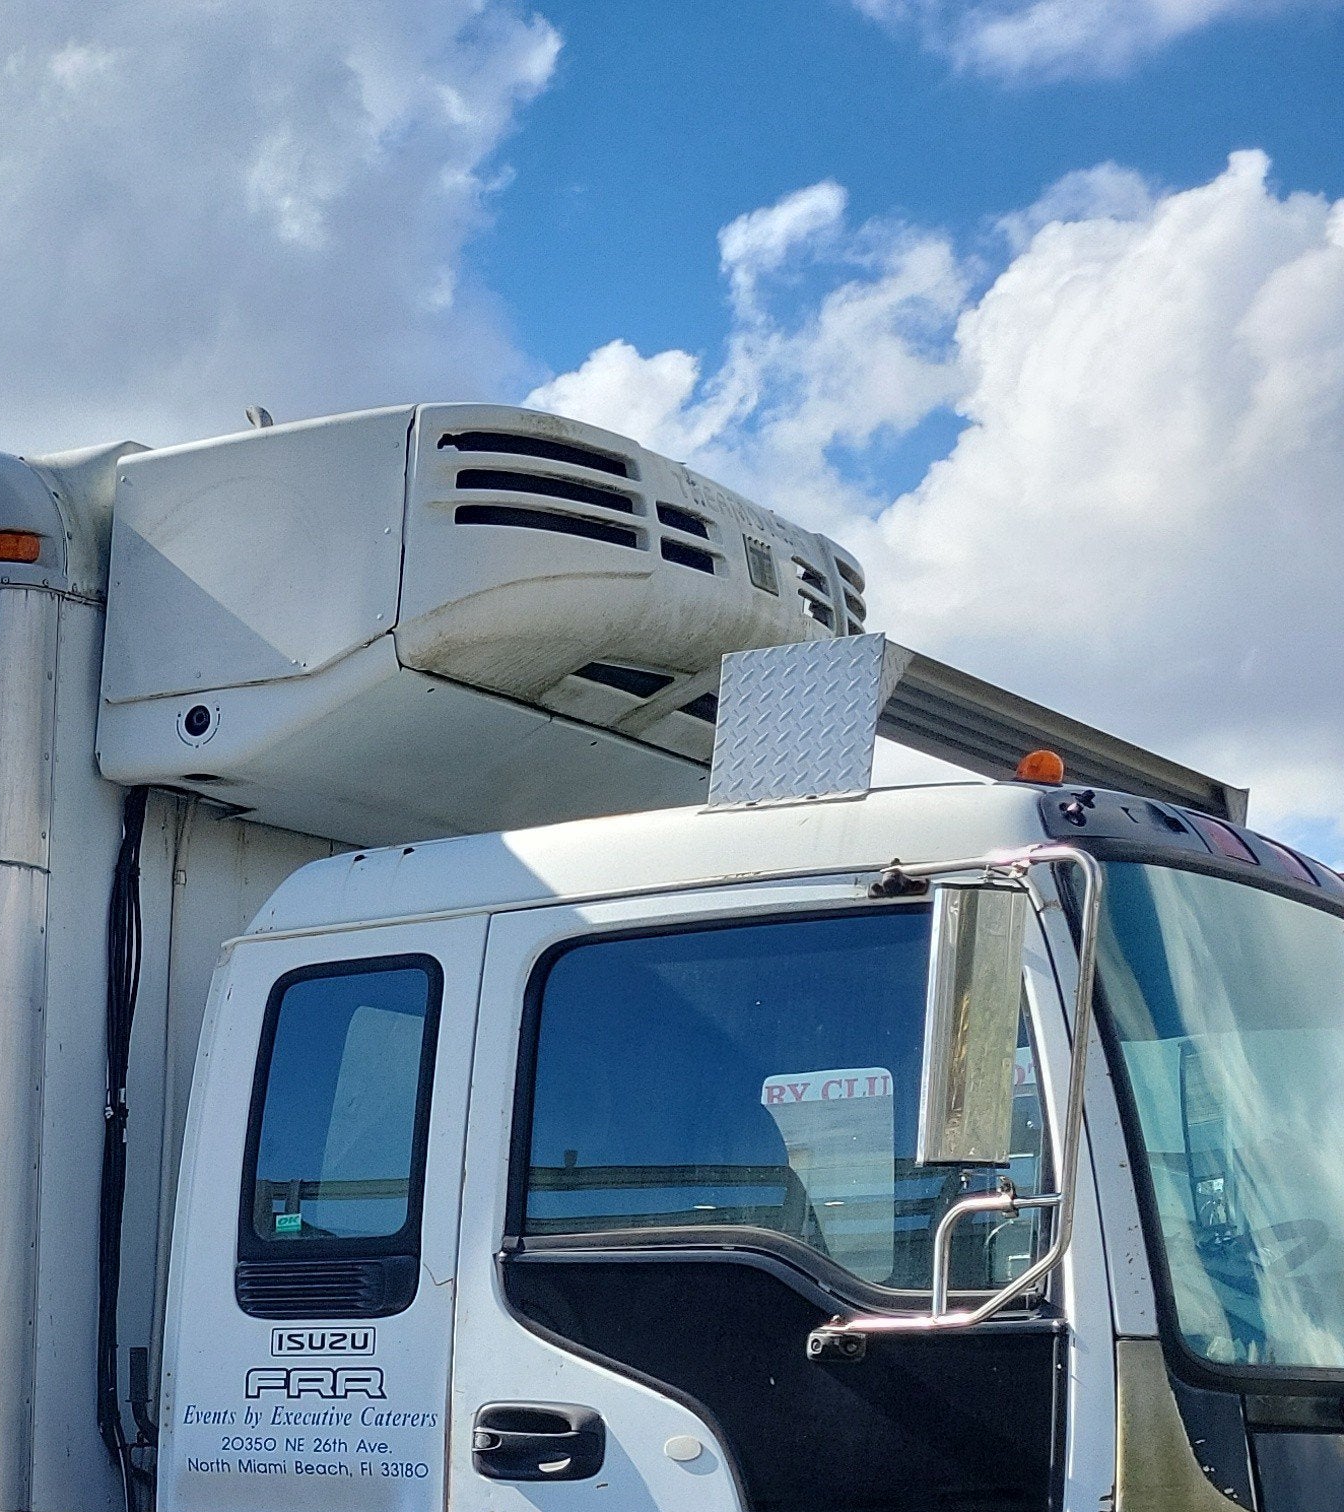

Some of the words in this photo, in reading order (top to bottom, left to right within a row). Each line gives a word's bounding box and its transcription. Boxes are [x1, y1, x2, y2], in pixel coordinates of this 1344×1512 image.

[277, 1331, 370, 1352] ISUZU
[244, 1366, 388, 1400] FRR
[183, 1404, 237, 1426] Events
[243, 1405, 263, 1429] by
[269, 1405, 352, 1427] Executive
[360, 1406, 439, 1428] Caterers
[221, 1436, 277, 1452] 20350
[285, 1437, 305, 1452] NE
[313, 1438, 348, 1453] 26th
[356, 1439, 393, 1454] Ave.
[187, 1457, 231, 1474] North
[237, 1458, 287, 1475] Miami
[295, 1460, 353, 1477] Beach,
[381, 1463, 429, 1478] 33180
